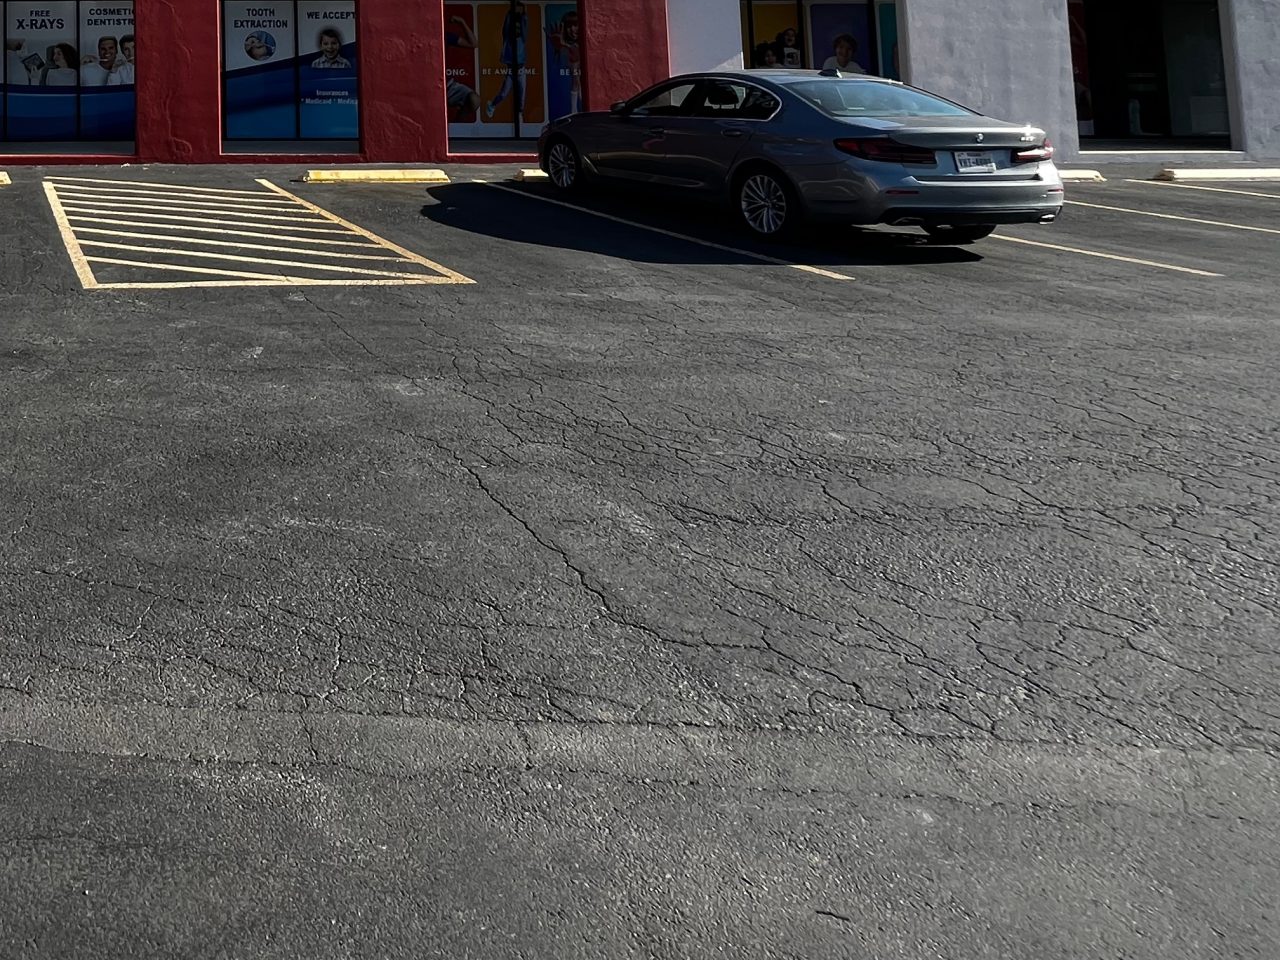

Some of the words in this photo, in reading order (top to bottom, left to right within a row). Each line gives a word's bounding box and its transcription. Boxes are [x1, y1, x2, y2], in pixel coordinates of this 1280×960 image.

[246, 8, 275, 17] TOOTH
[306, 11, 320, 20] WE
[322, 11, 357, 20] ACCEPT
[16, 18, 65, 30] X-RAYS
[233, 19, 288, 29] EXTRACTION
[482, 68, 492, 76] BE
[494, 68, 537, 76] AWEOME.
[559, 68, 571, 76] BE
